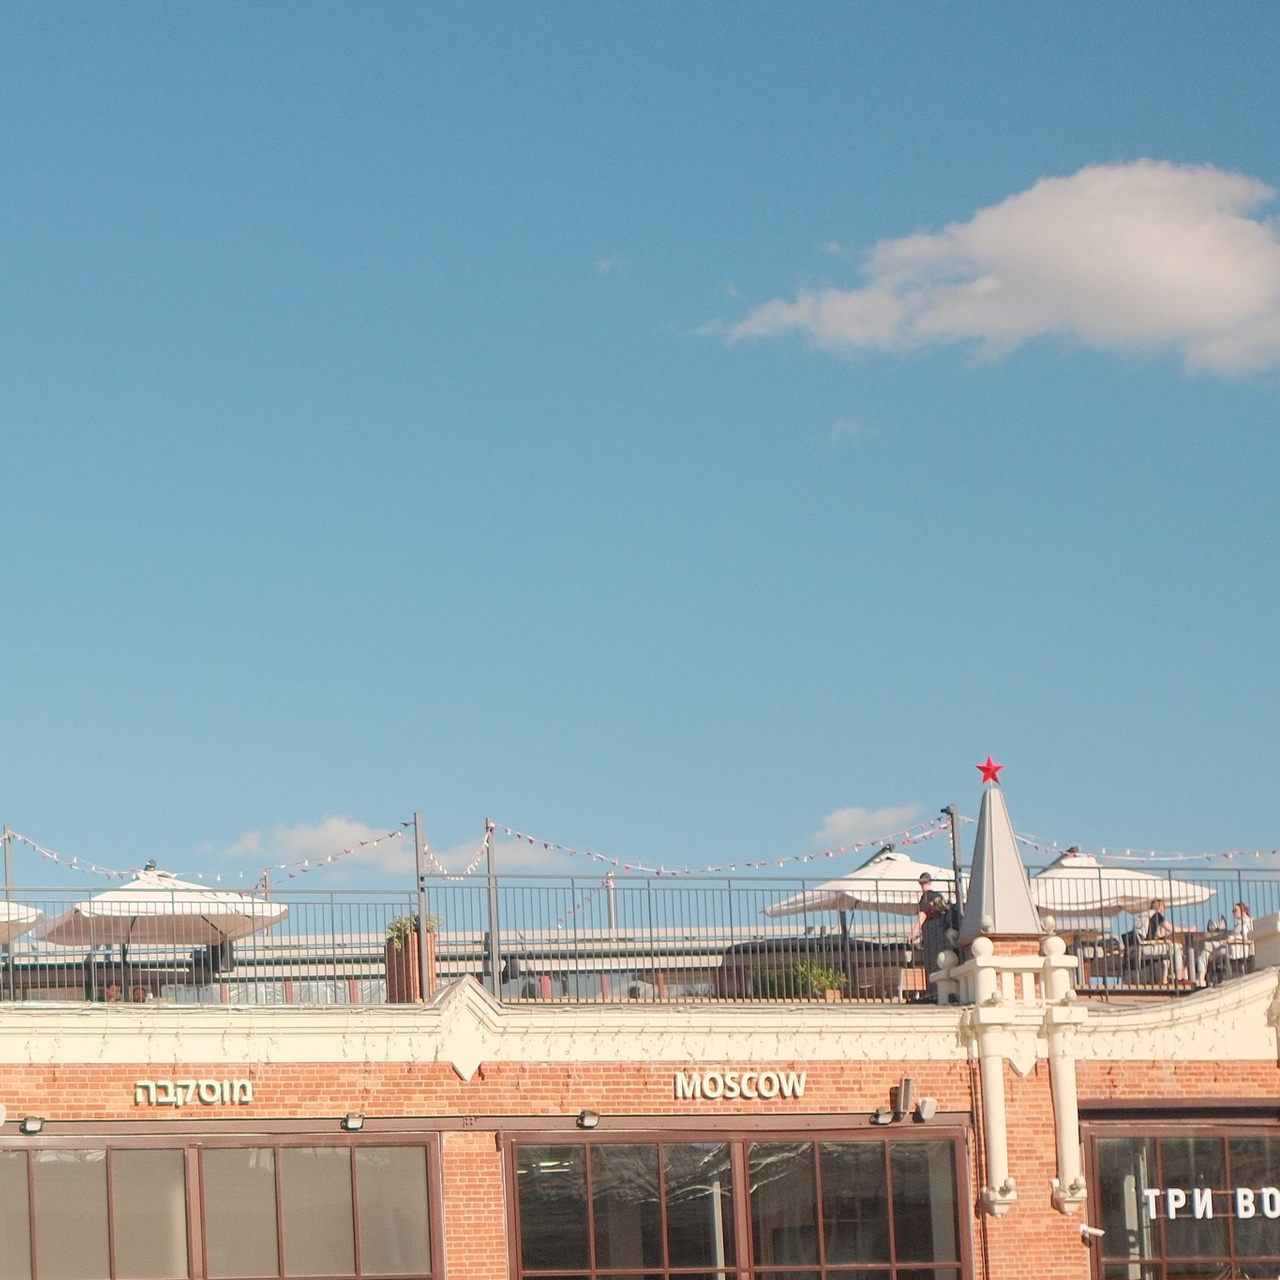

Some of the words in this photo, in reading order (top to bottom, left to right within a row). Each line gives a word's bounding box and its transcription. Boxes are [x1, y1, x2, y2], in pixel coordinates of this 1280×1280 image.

[134, 1079, 253, 1107] מוסקבה
[675, 1072, 807, 1100] MOSCOW
[1143, 1187, 1213, 1220] ТРИ
